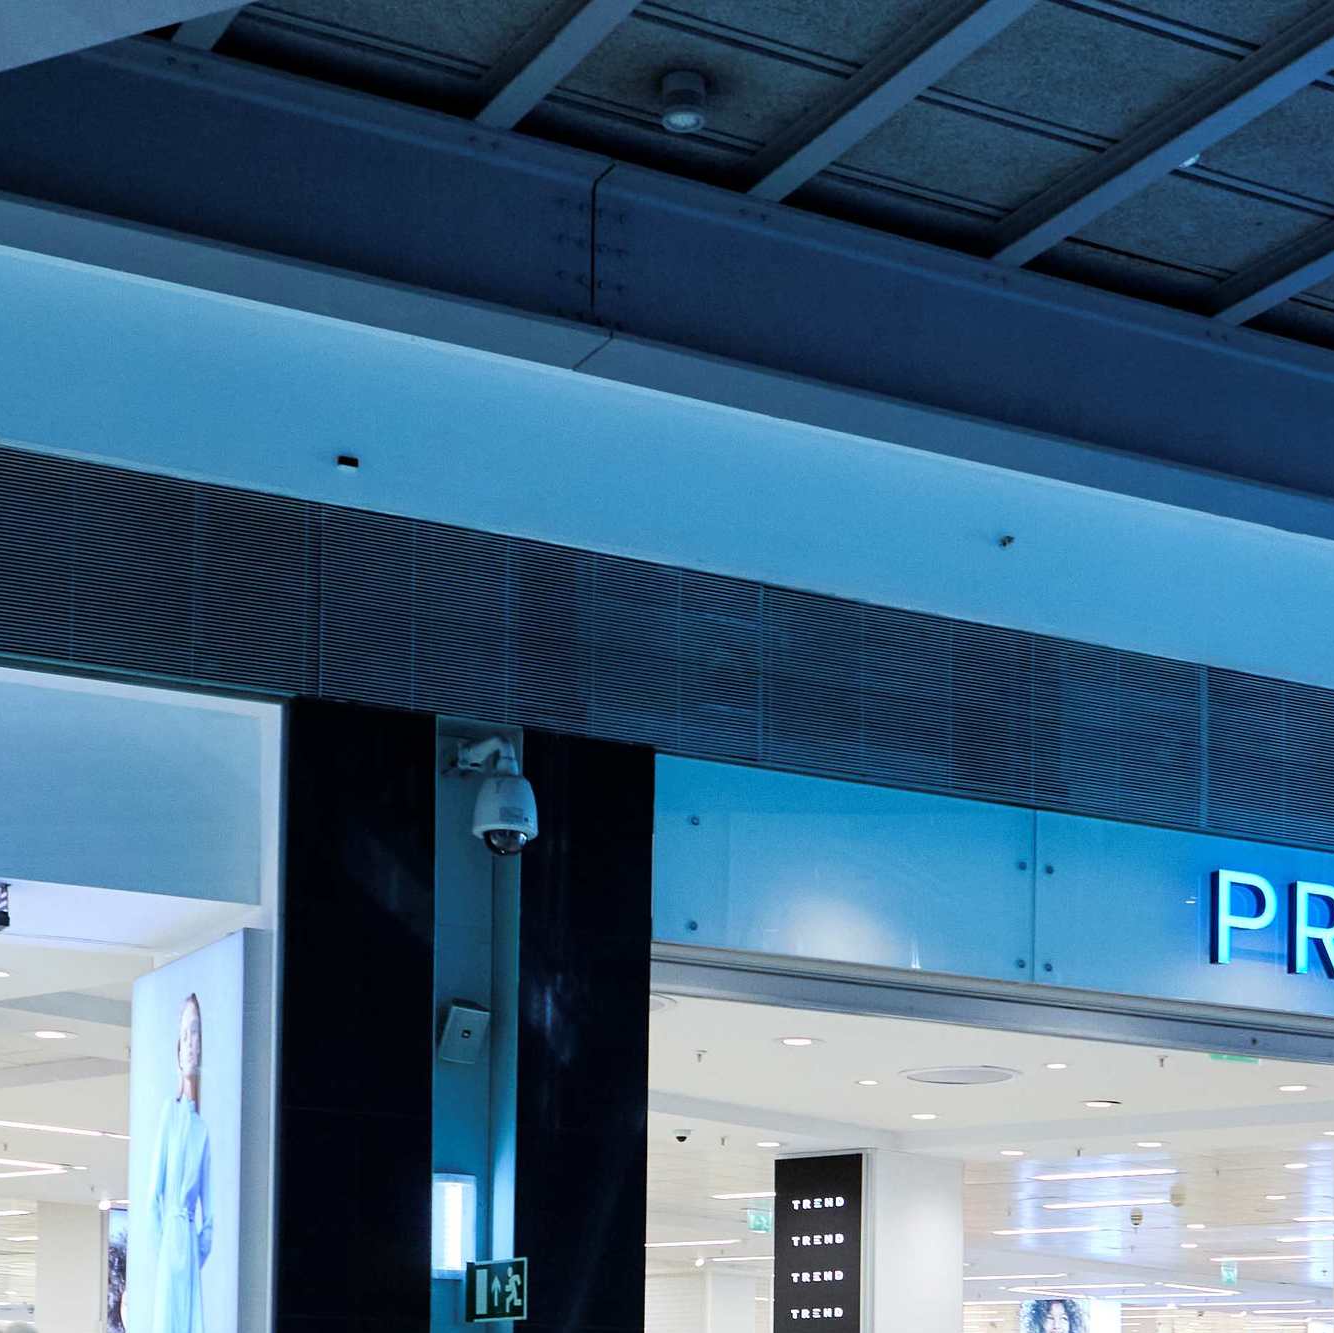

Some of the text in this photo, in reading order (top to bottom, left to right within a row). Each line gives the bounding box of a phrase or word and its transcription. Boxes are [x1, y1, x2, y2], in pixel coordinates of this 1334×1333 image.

[792, 1197, 844, 1210] TREND
[792, 1233, 844, 1246] TREND
[791, 1271, 843, 1283] TREND
[791, 1307, 843, 1319] TREND
